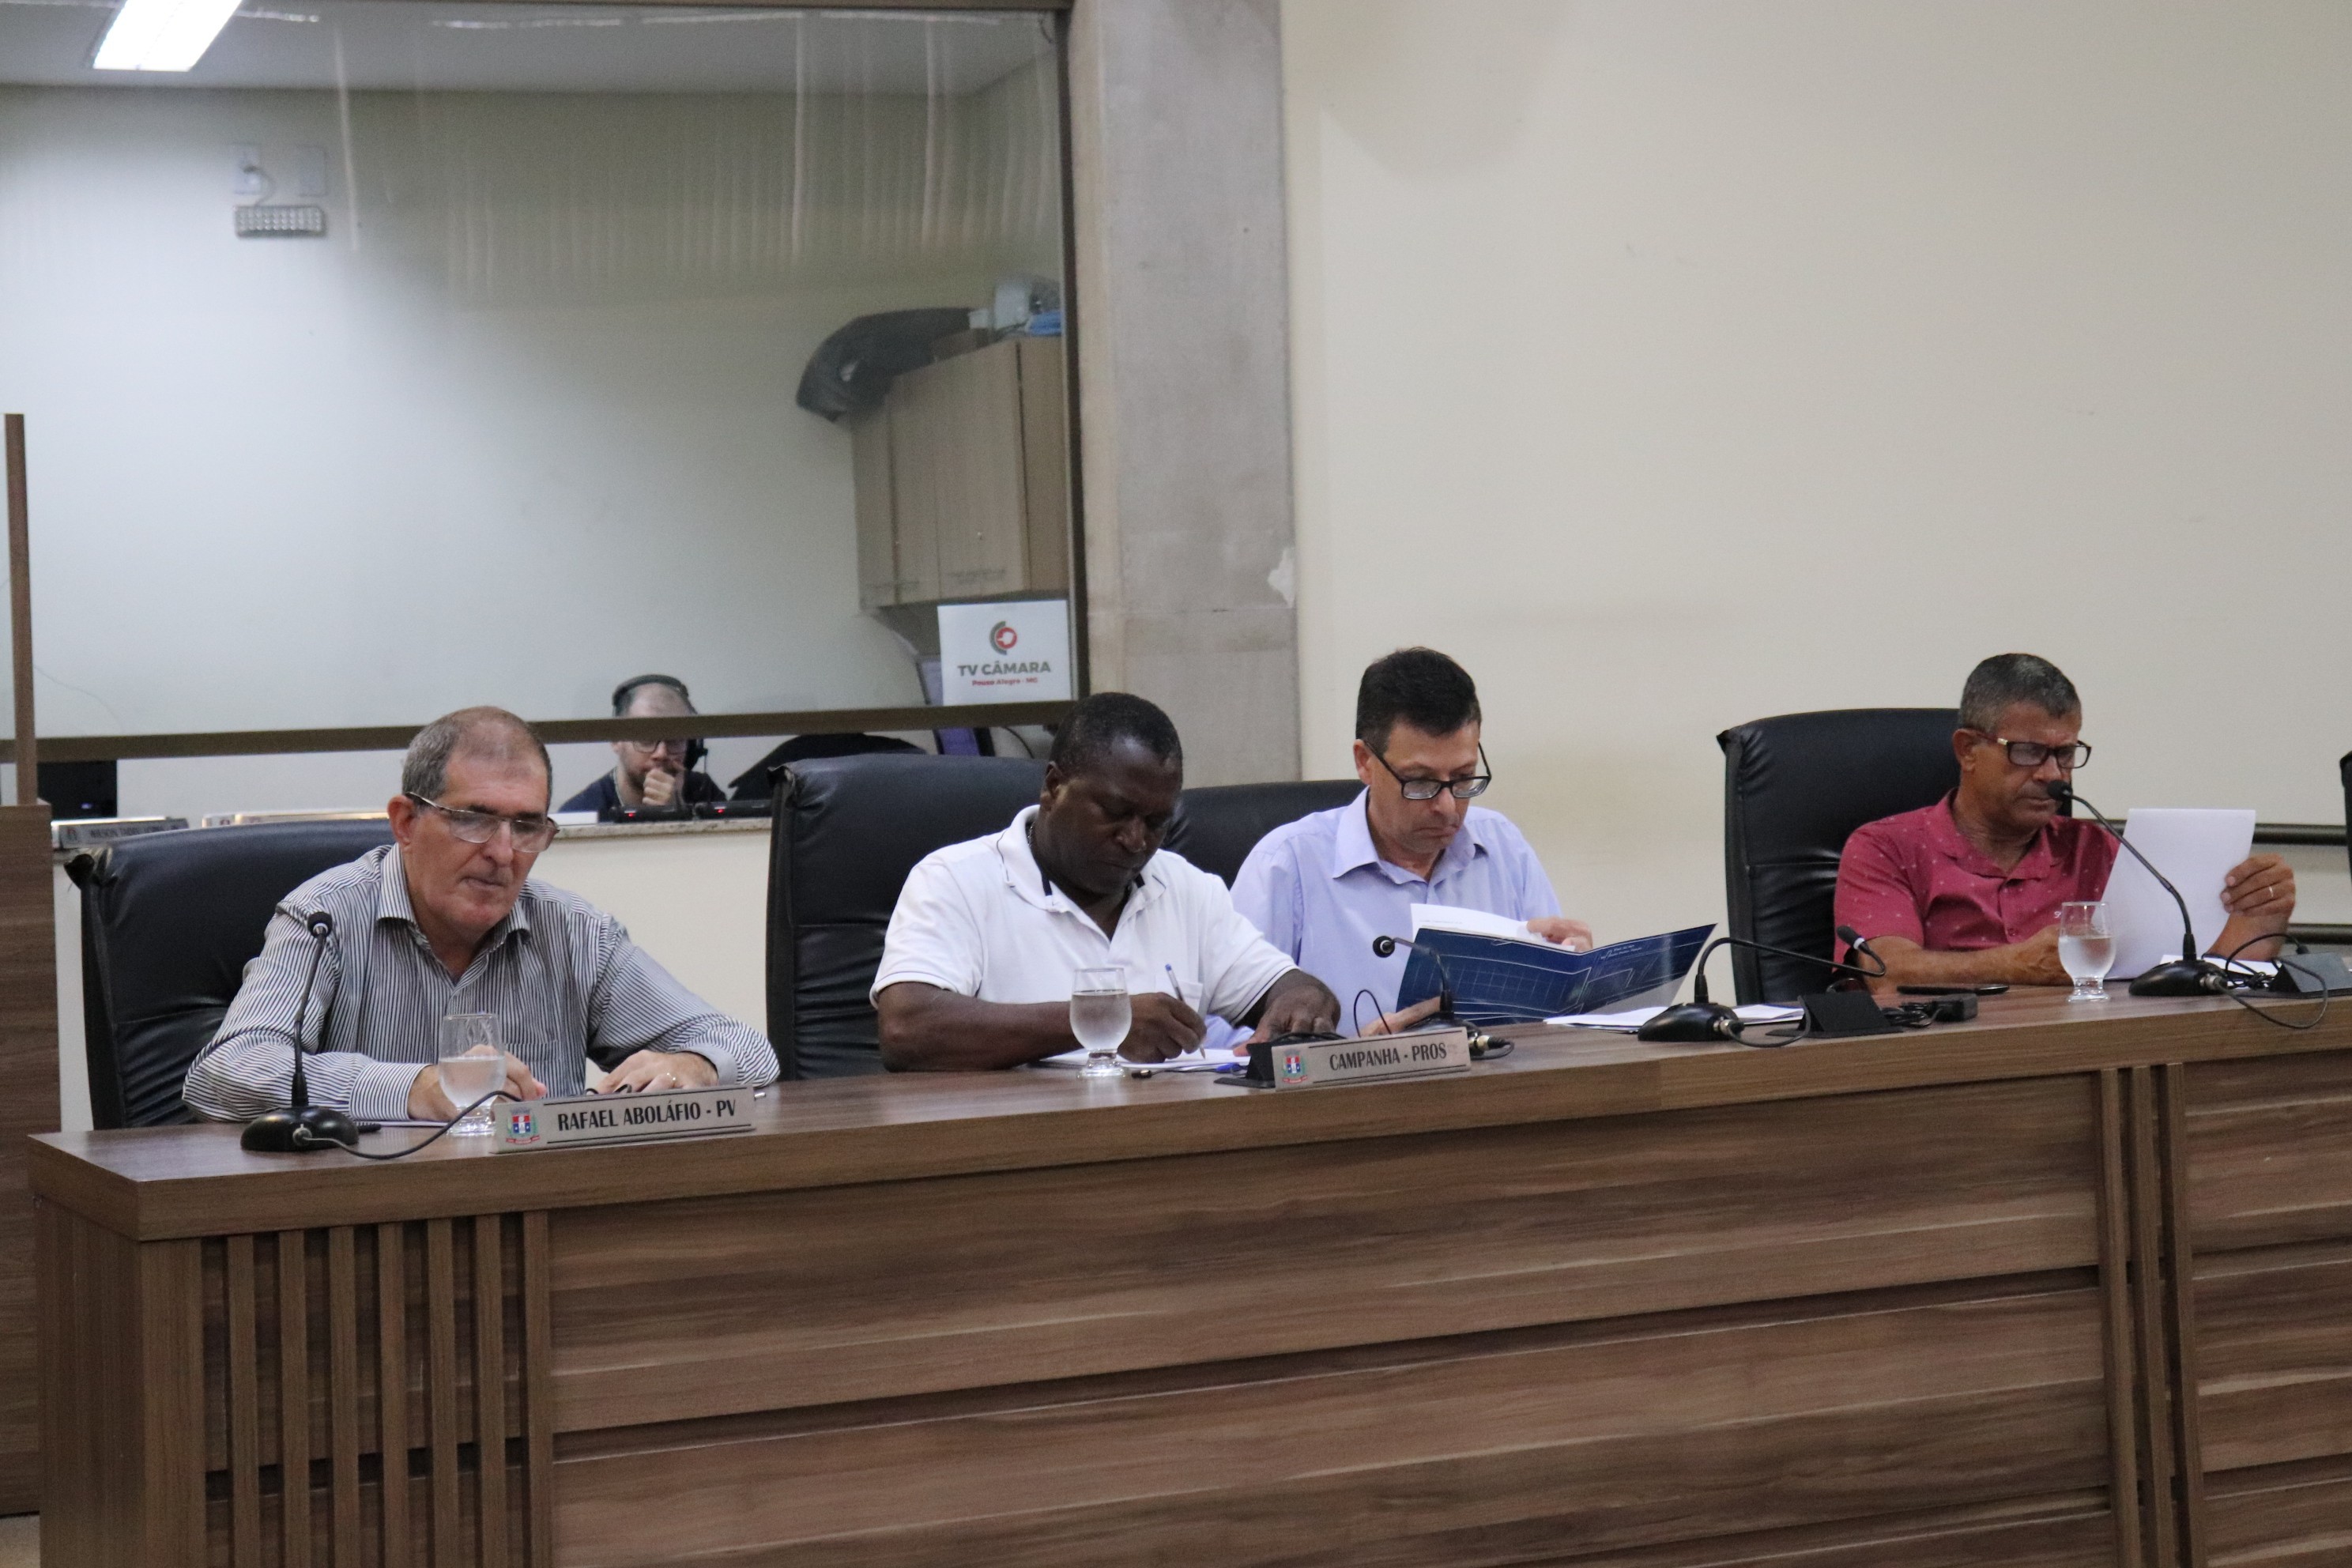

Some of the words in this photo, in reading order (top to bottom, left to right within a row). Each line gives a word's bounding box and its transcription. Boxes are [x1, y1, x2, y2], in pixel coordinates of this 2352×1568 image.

[957, 664, 978, 677] TV
[981, 660, 1051, 676] CÂMARA
[1329, 1048, 1400, 1071] CAMPANHA
[1412, 1043, 1446, 1061] PROS
[558, 1109, 619, 1131] RAFAEL
[623, 1100, 701, 1125] ABOLÁFIO
[717, 1099, 736, 1118] PV
